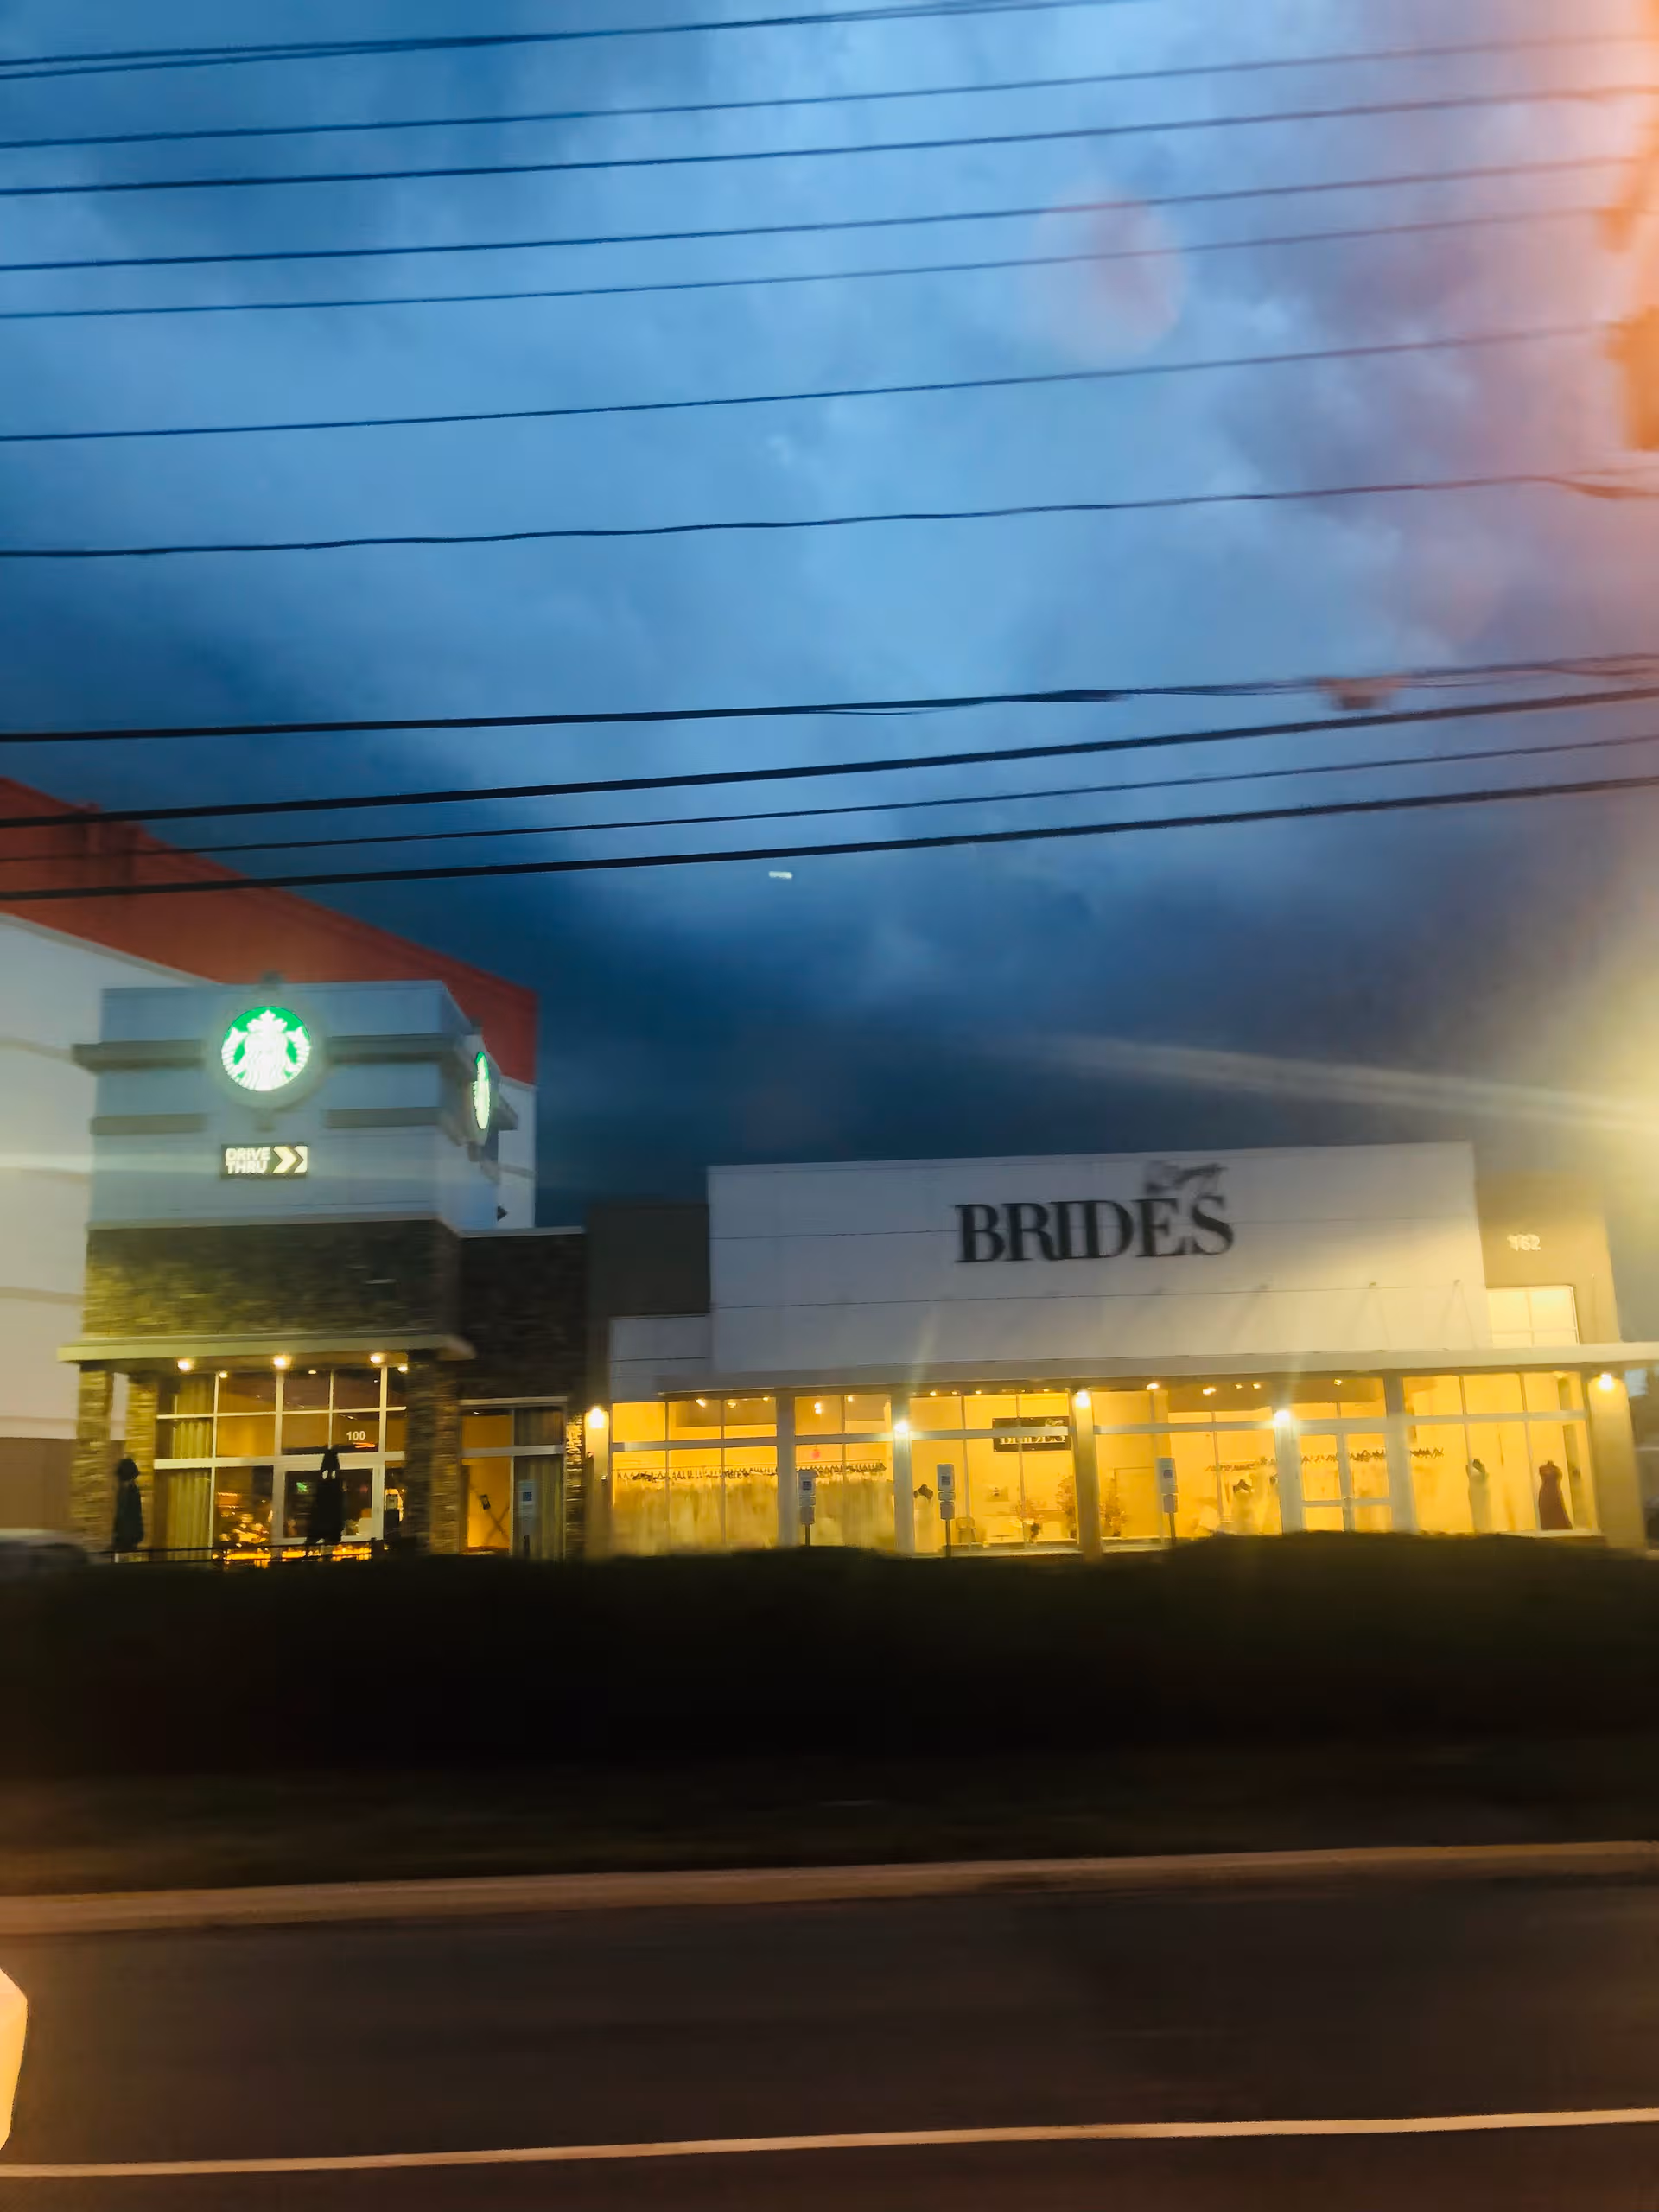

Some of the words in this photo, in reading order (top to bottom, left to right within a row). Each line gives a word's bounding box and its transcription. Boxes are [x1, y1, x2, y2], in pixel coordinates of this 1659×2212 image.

[226, 1147, 270, 1161] DRIVE
[226, 1160, 268, 1174] THRU
[953, 1195, 1233, 1262] BRIDES
[346, 1431, 365, 1440] 100
